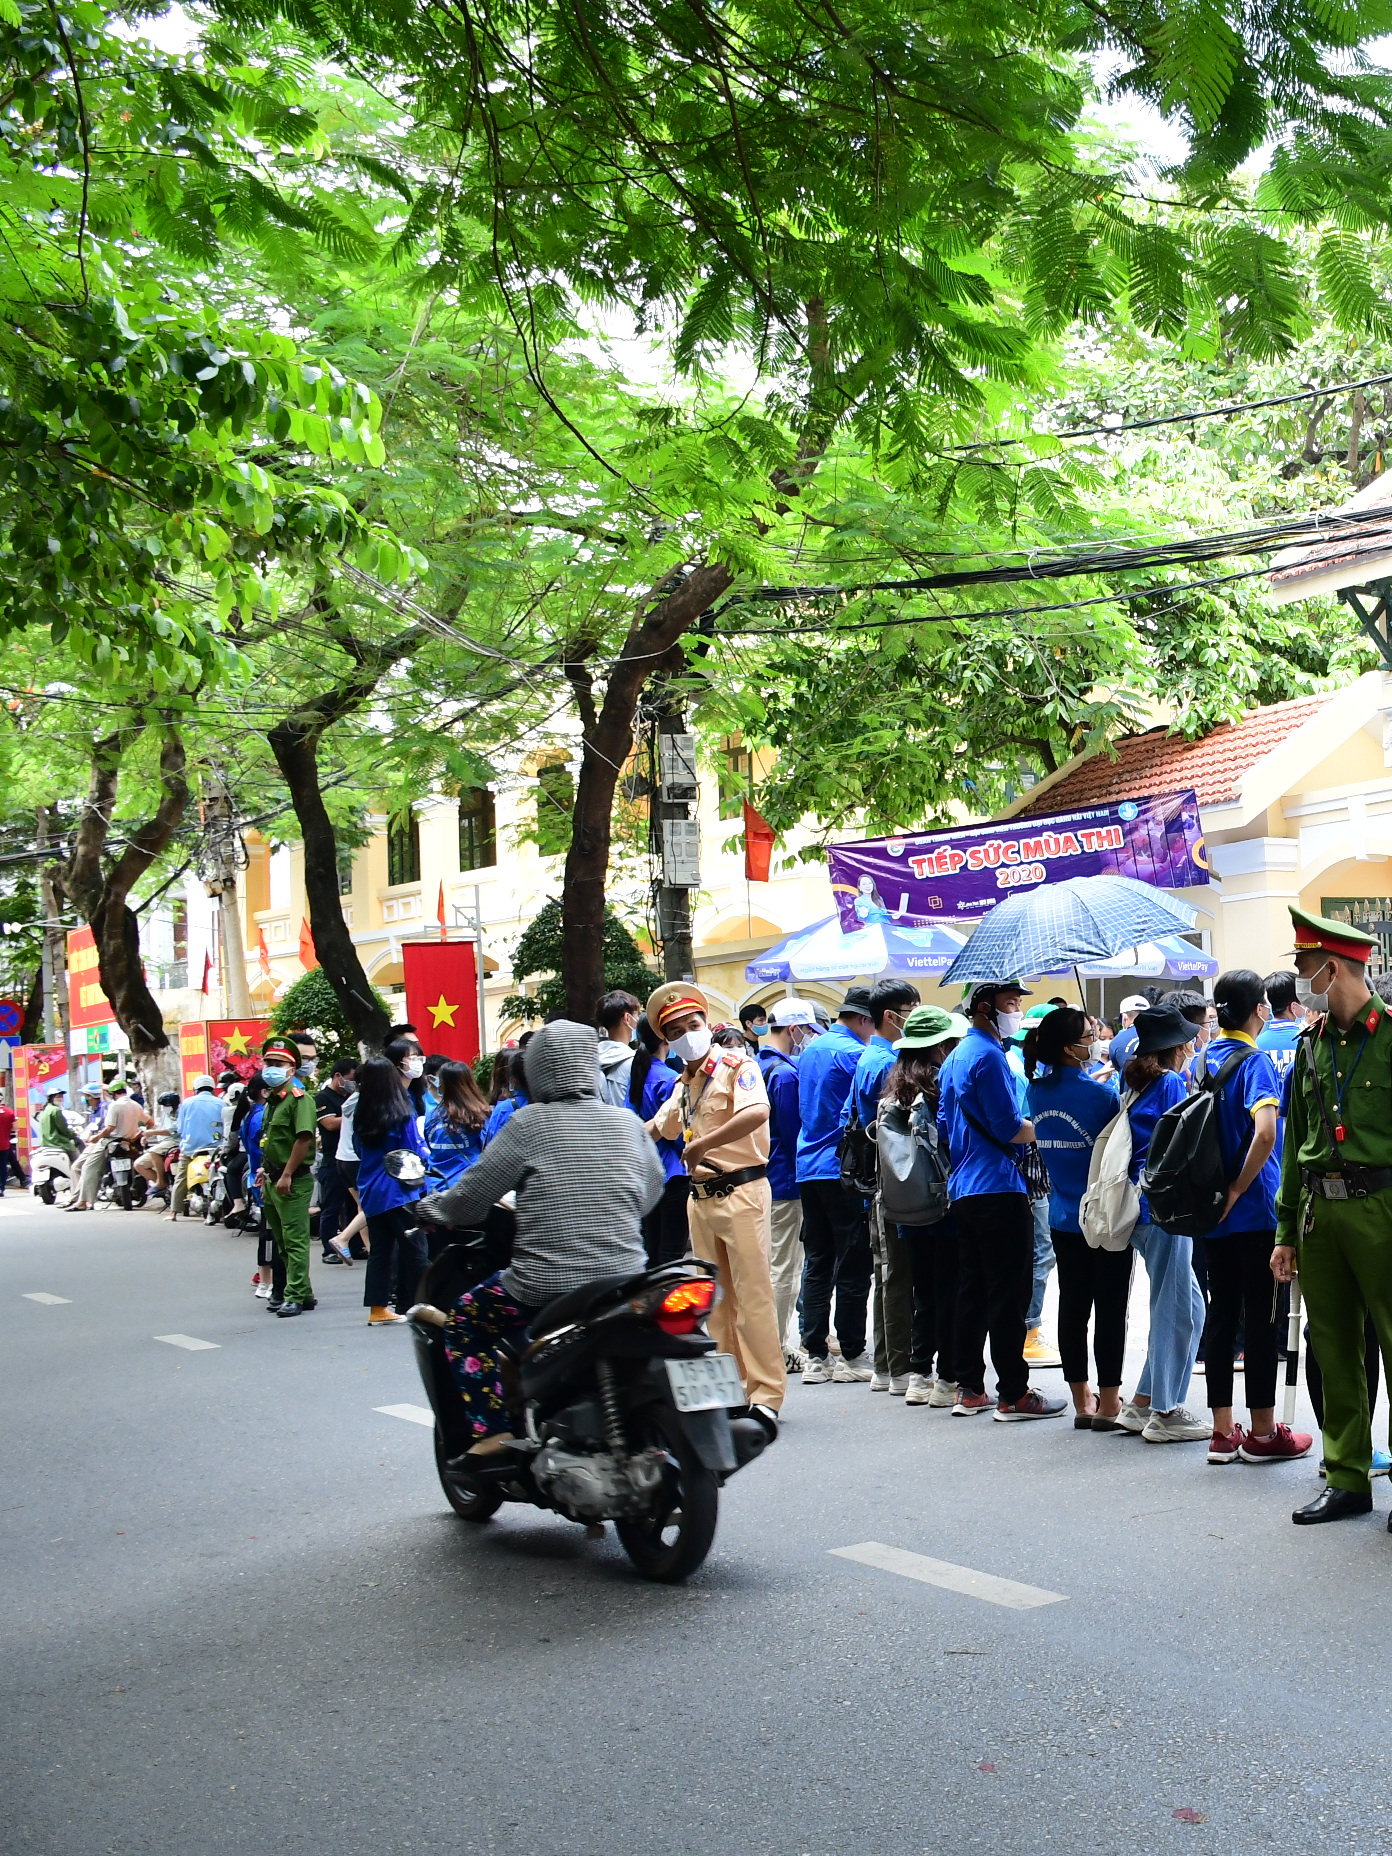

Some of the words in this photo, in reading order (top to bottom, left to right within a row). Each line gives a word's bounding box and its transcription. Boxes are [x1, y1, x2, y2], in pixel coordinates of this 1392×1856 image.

[909, 846, 965, 879] TIẾP
[967, 840, 1020, 870] SỨC
[1021, 831, 1080, 865] MÙA
[1078, 824, 1124, 853] THI
[996, 863, 1046, 888] 2020
[907, 956, 955, 968] ViettelPa
[1178, 961, 1209, 973] ViettelPay
[1053, 1139, 1087, 1149] VOLUNTEERS
